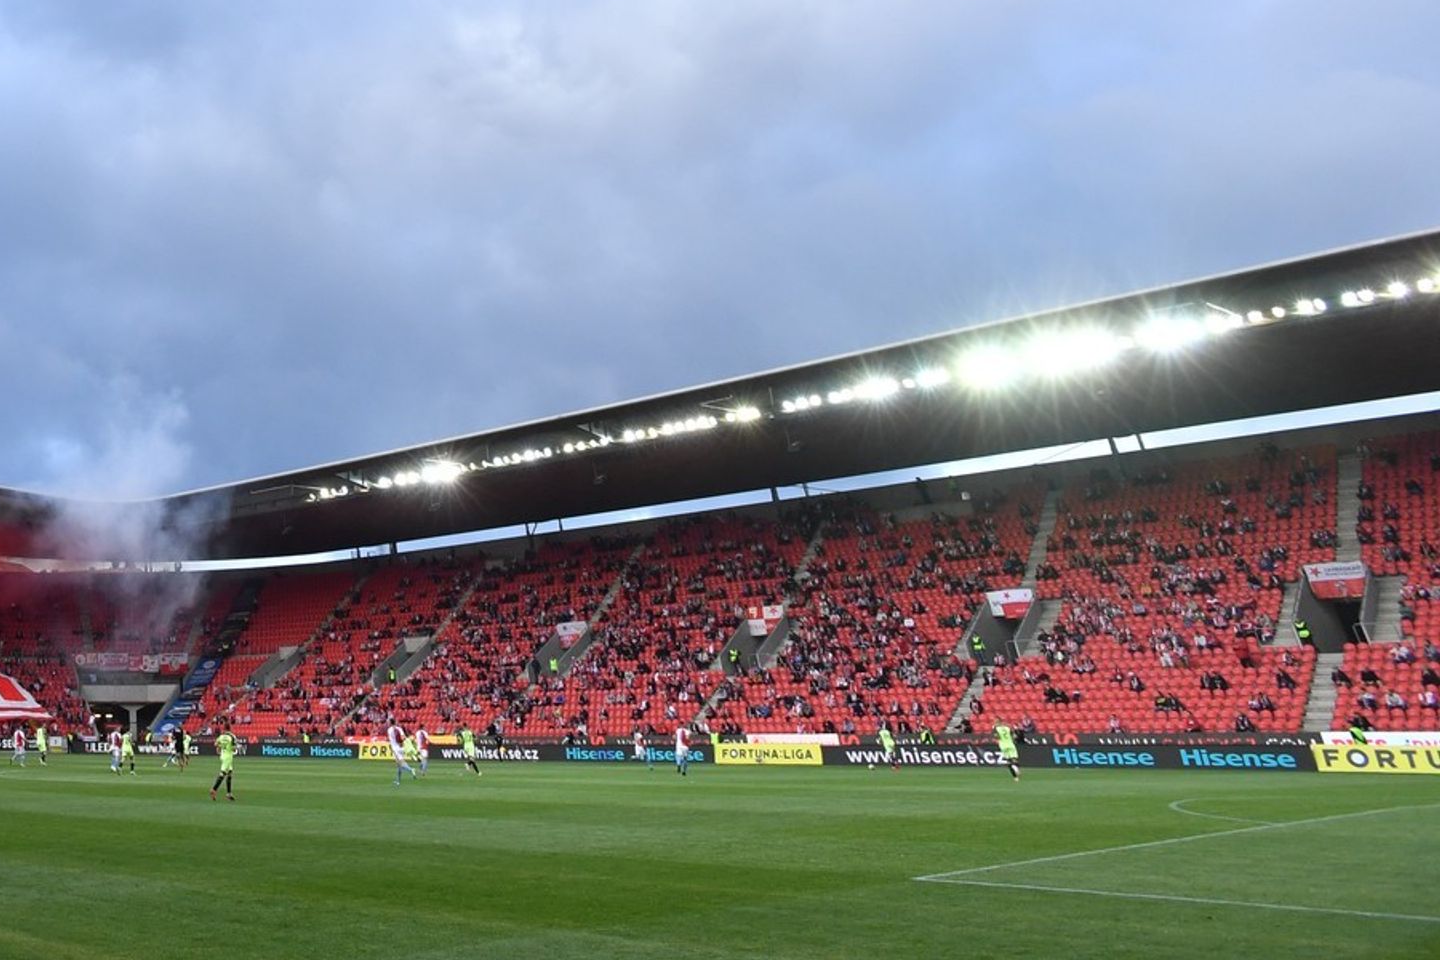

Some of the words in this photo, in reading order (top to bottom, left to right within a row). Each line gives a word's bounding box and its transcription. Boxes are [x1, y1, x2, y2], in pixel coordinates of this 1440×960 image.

[262, 745, 301, 756] Hisense
[310, 745, 352, 757] Hisense
[566, 747, 625, 761] Hisense
[644, 747, 704, 761] Hisese
[846, 747, 1008, 765] www.hisense.cz
[1052, 748, 1155, 766] Hisense
[1180, 749, 1297, 768] Hisense
